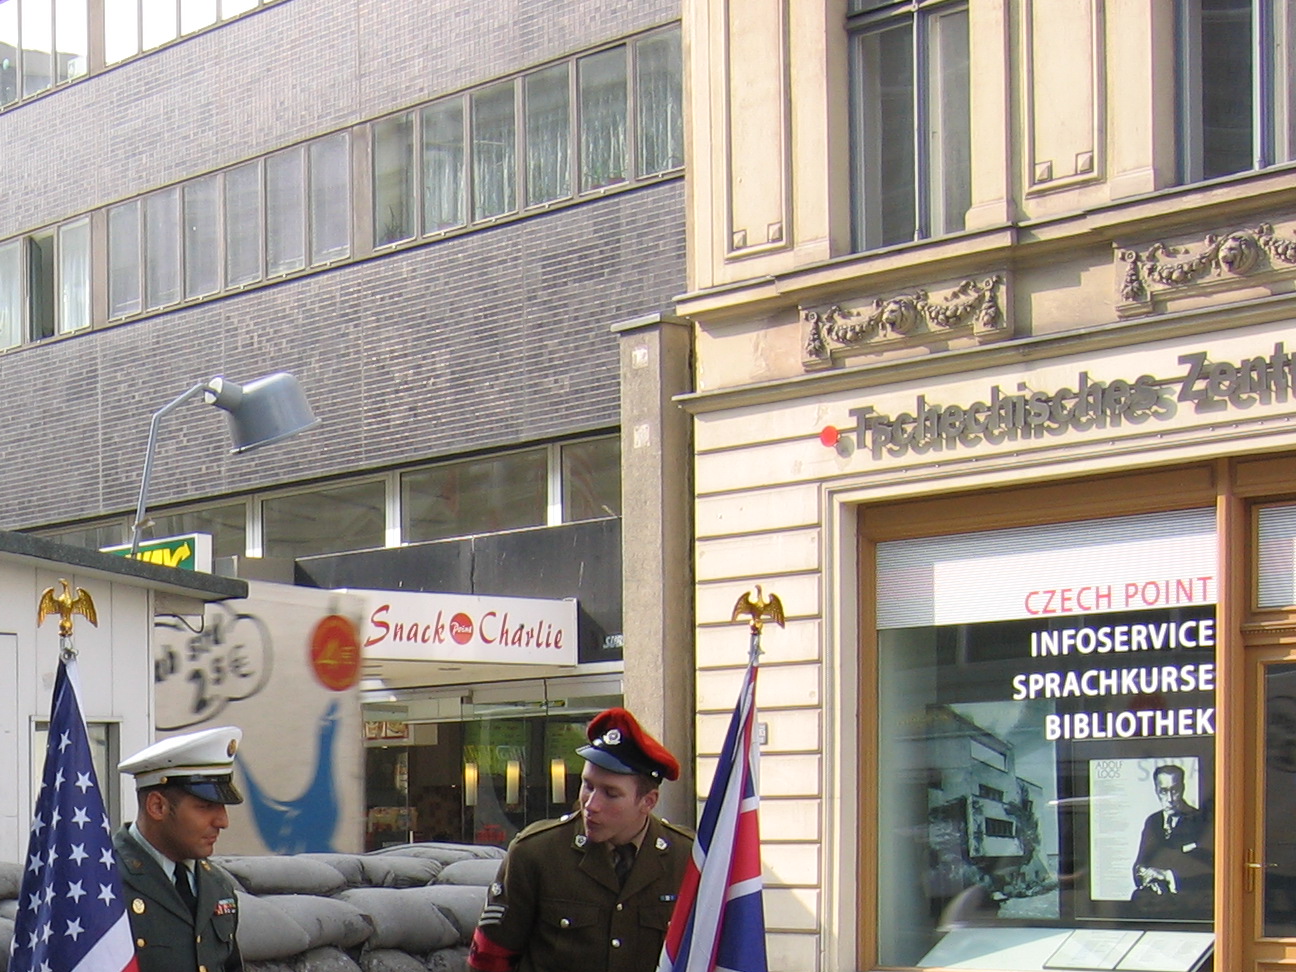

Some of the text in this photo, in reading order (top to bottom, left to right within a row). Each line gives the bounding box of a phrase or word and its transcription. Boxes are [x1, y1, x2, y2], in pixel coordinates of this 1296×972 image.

[848, 371, 1159, 449] Tschechisches
[1024, 576, 1213, 615] CZECH POINT
[364, 604, 564, 650] Snack Point Charlie
[1030, 618, 1215, 658] INFOSERVICE
[1011, 663, 1215, 701] SPRACHKURSE
[1044, 708, 1216, 741] BIBLIOTHEK
[1095, 760, 1123, 770] ADOLF
[1097, 769, 1121, 779] LOOS
